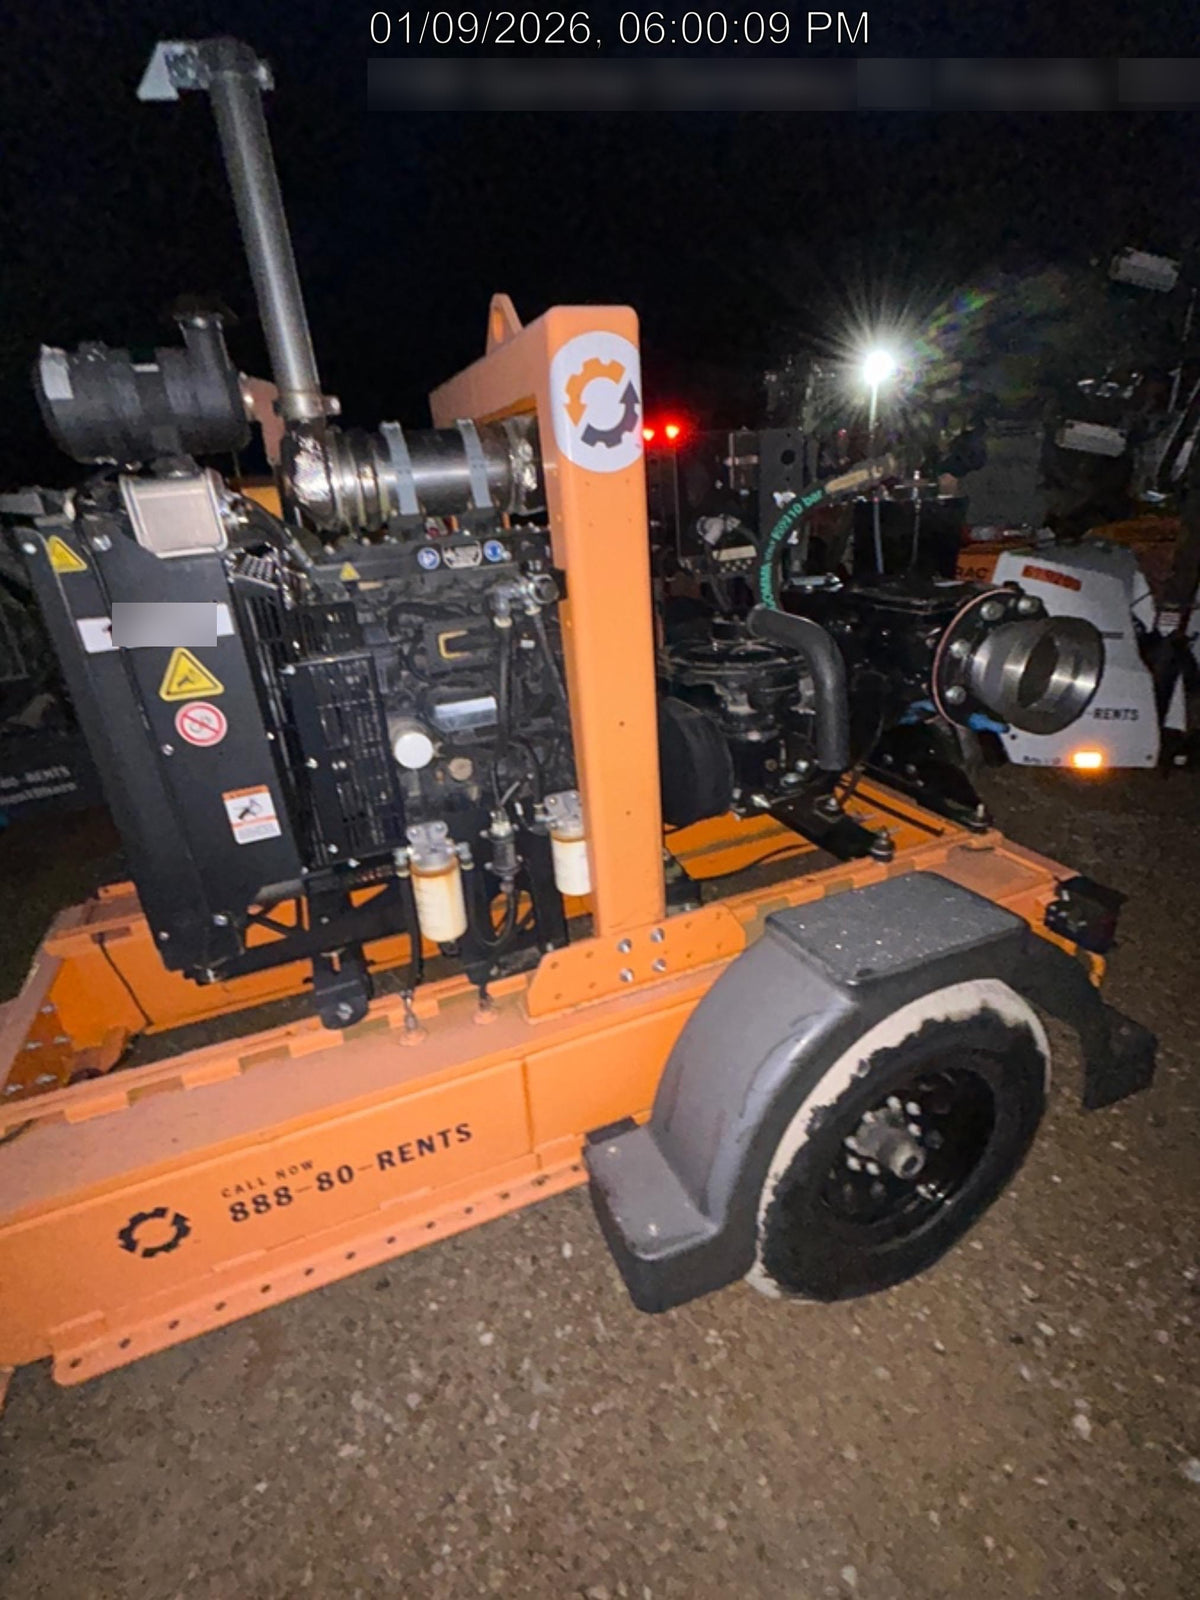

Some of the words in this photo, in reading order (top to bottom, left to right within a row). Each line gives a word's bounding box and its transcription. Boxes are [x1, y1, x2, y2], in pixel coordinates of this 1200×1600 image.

[220, 1176, 267, 1198] CALL
[275, 1159, 315, 1179] NOW
[228, 1122, 473, 1223] 888-80-RENTS
